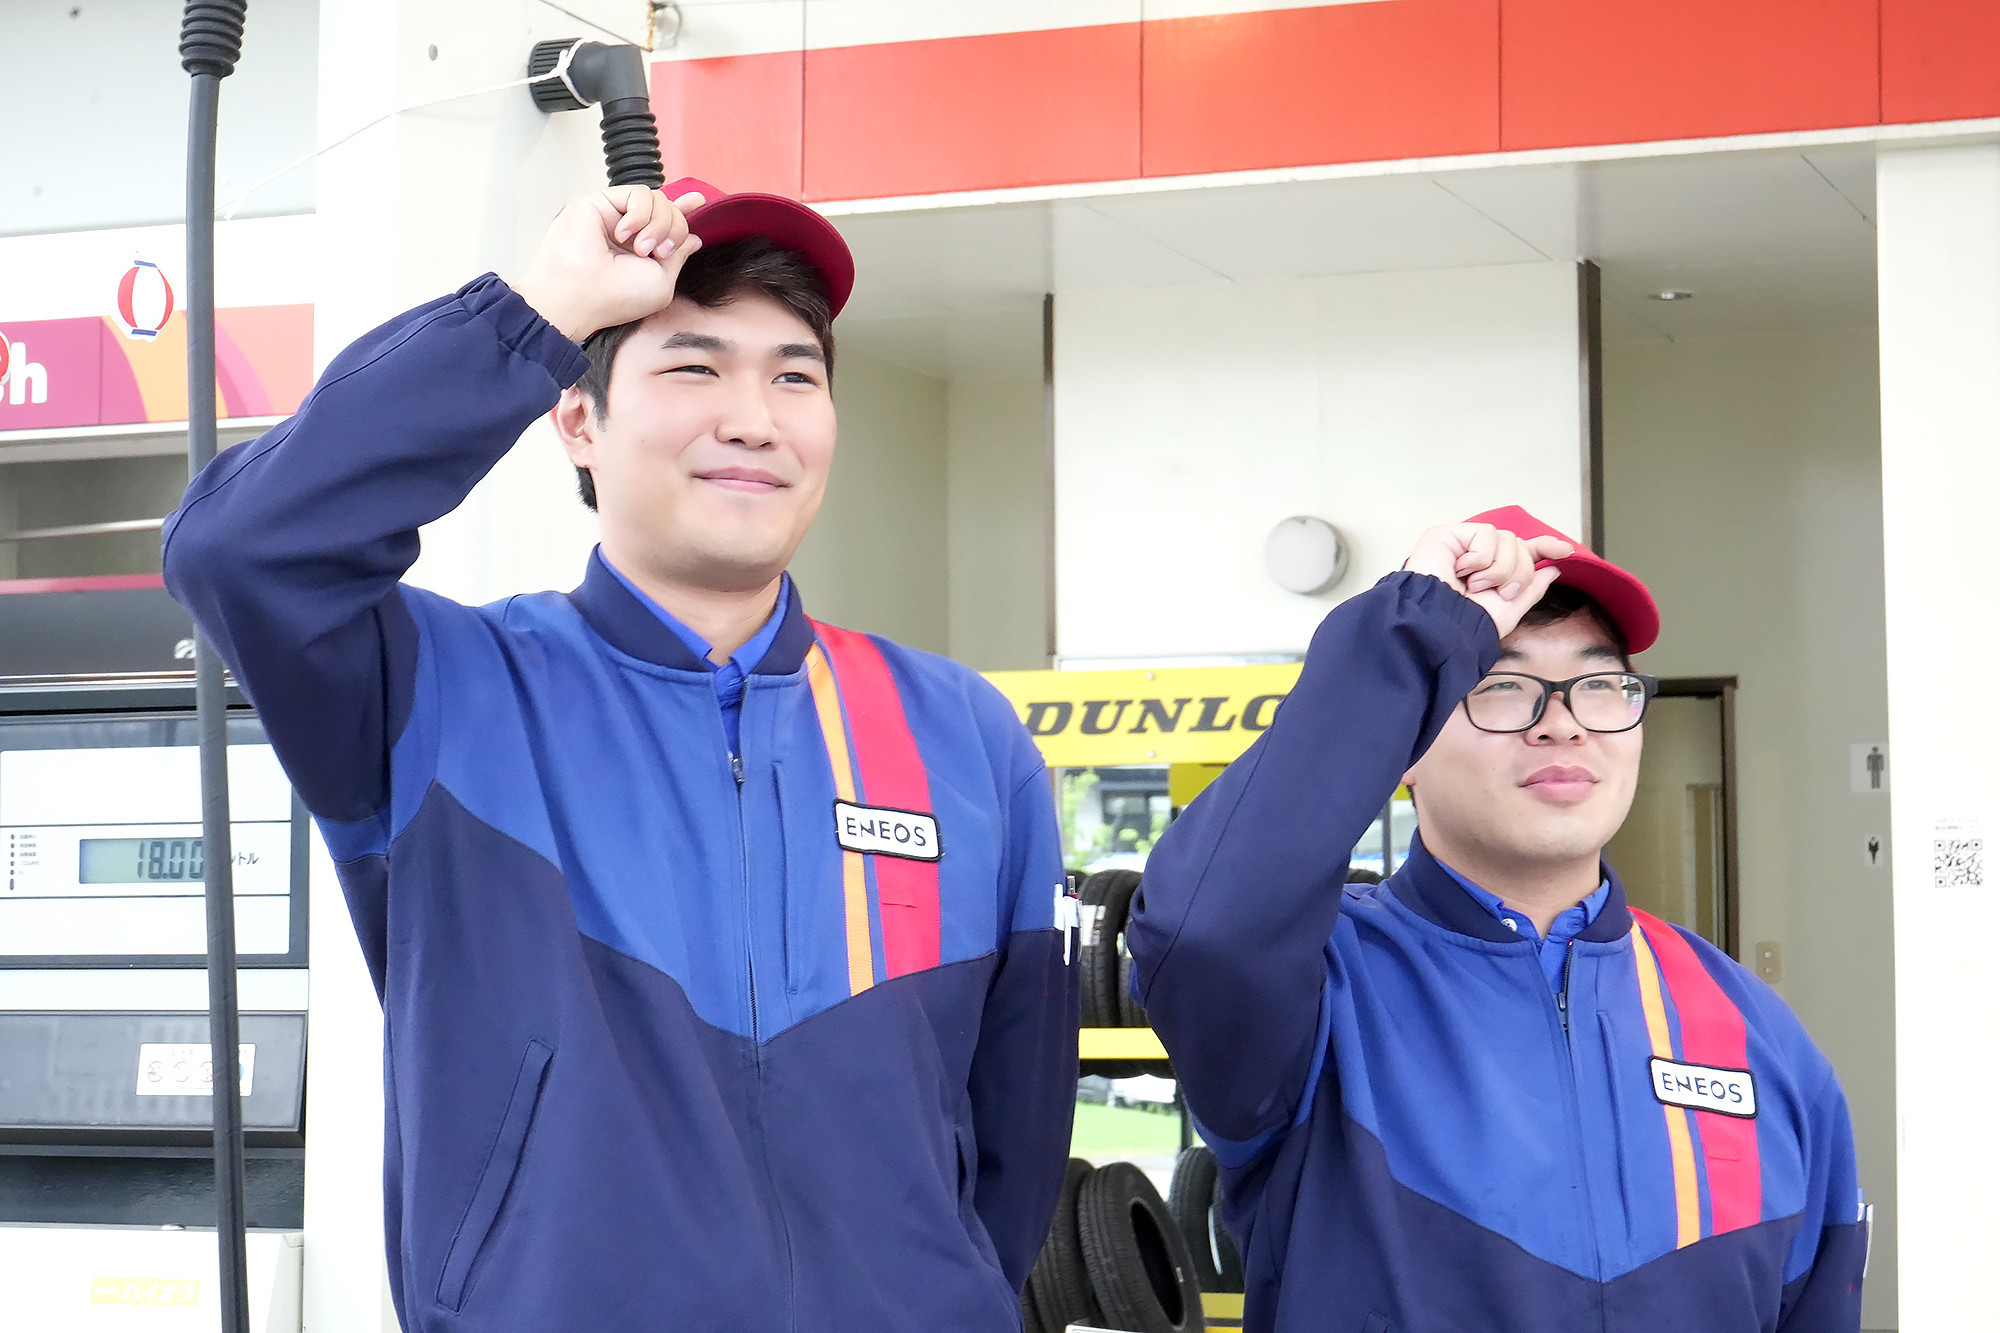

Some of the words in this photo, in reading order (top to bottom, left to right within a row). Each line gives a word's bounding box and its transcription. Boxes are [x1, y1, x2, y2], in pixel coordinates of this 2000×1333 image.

[0, 341, 48, 405] h
[846, 816, 927, 847] ENEOS
[137, 840, 204, 879] 18.00
[1661, 1071, 1743, 1104] ENEOS
